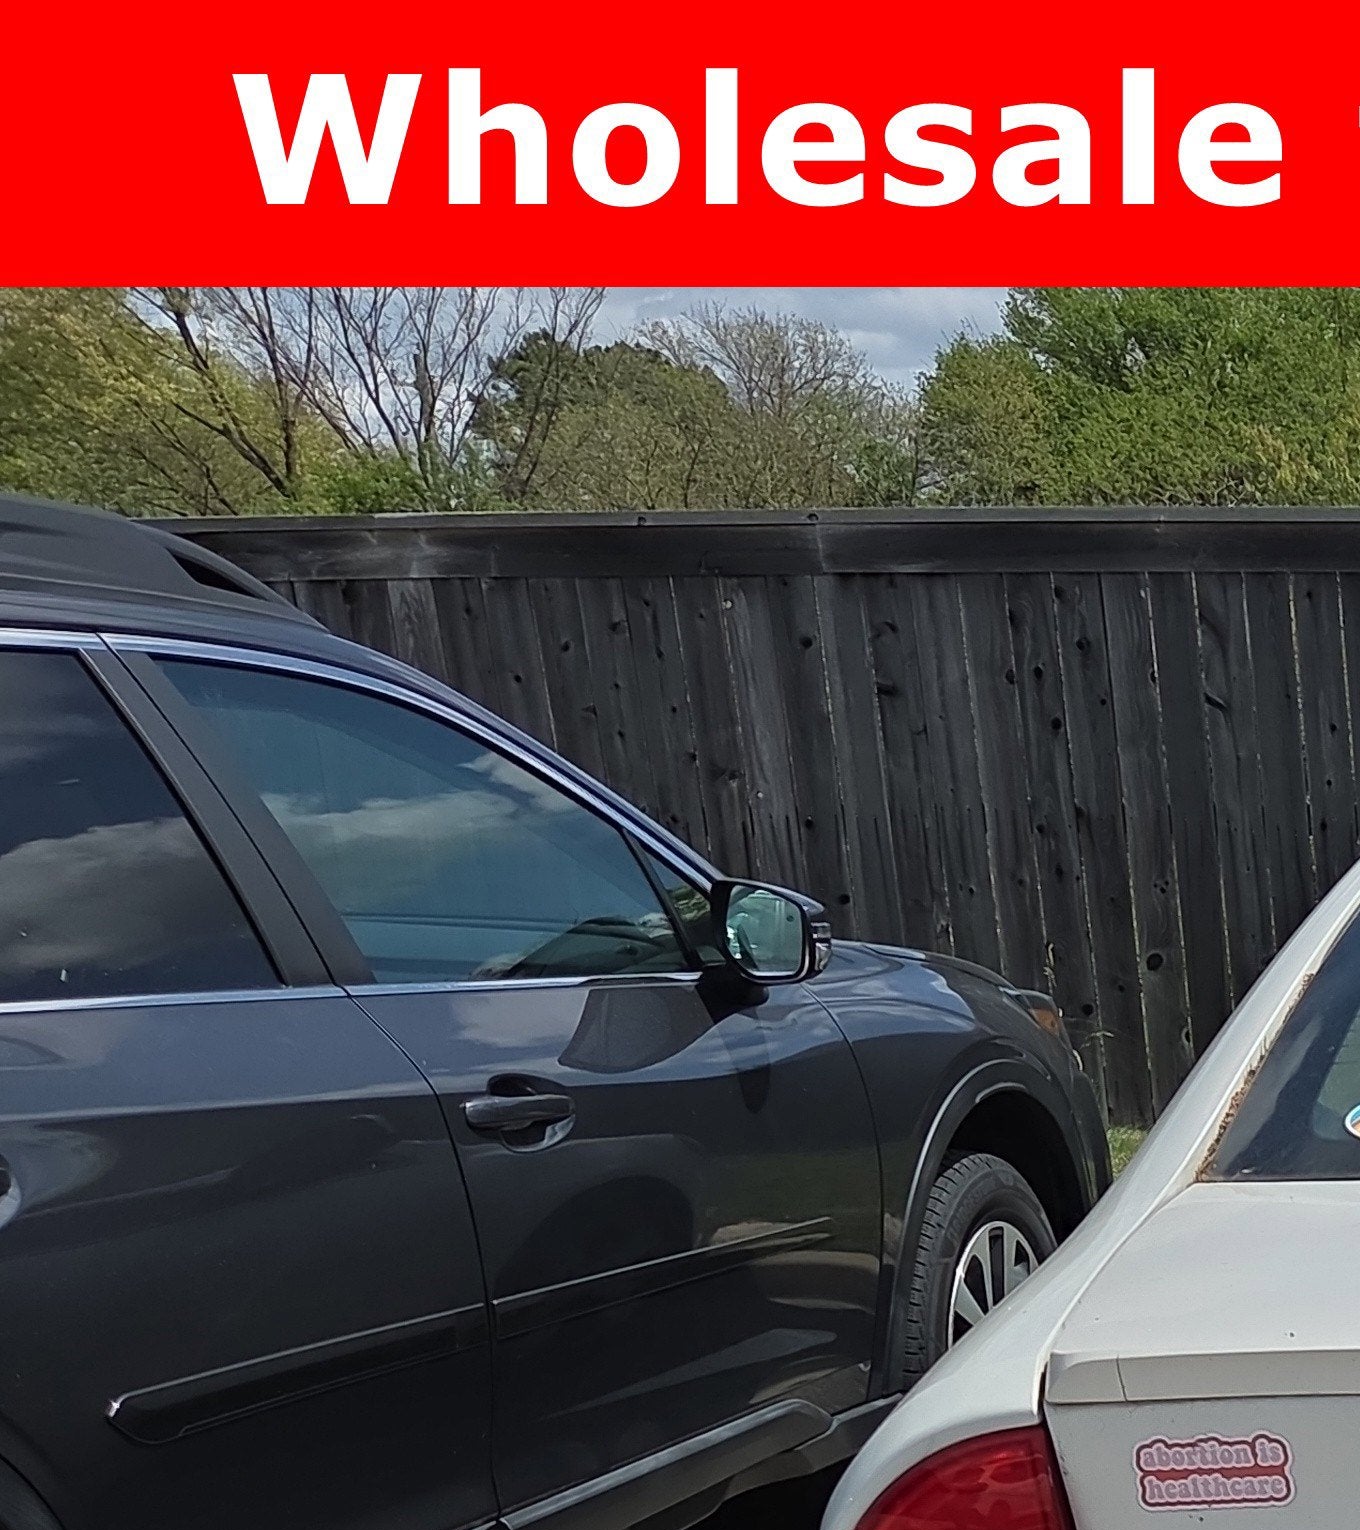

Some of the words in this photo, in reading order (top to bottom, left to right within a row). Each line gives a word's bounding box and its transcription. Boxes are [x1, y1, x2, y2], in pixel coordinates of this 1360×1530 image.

[1142, 1443, 1253, 1469] abortion
[1256, 1440, 1284, 1464] is
[1146, 1475, 1286, 1500] healthcare
